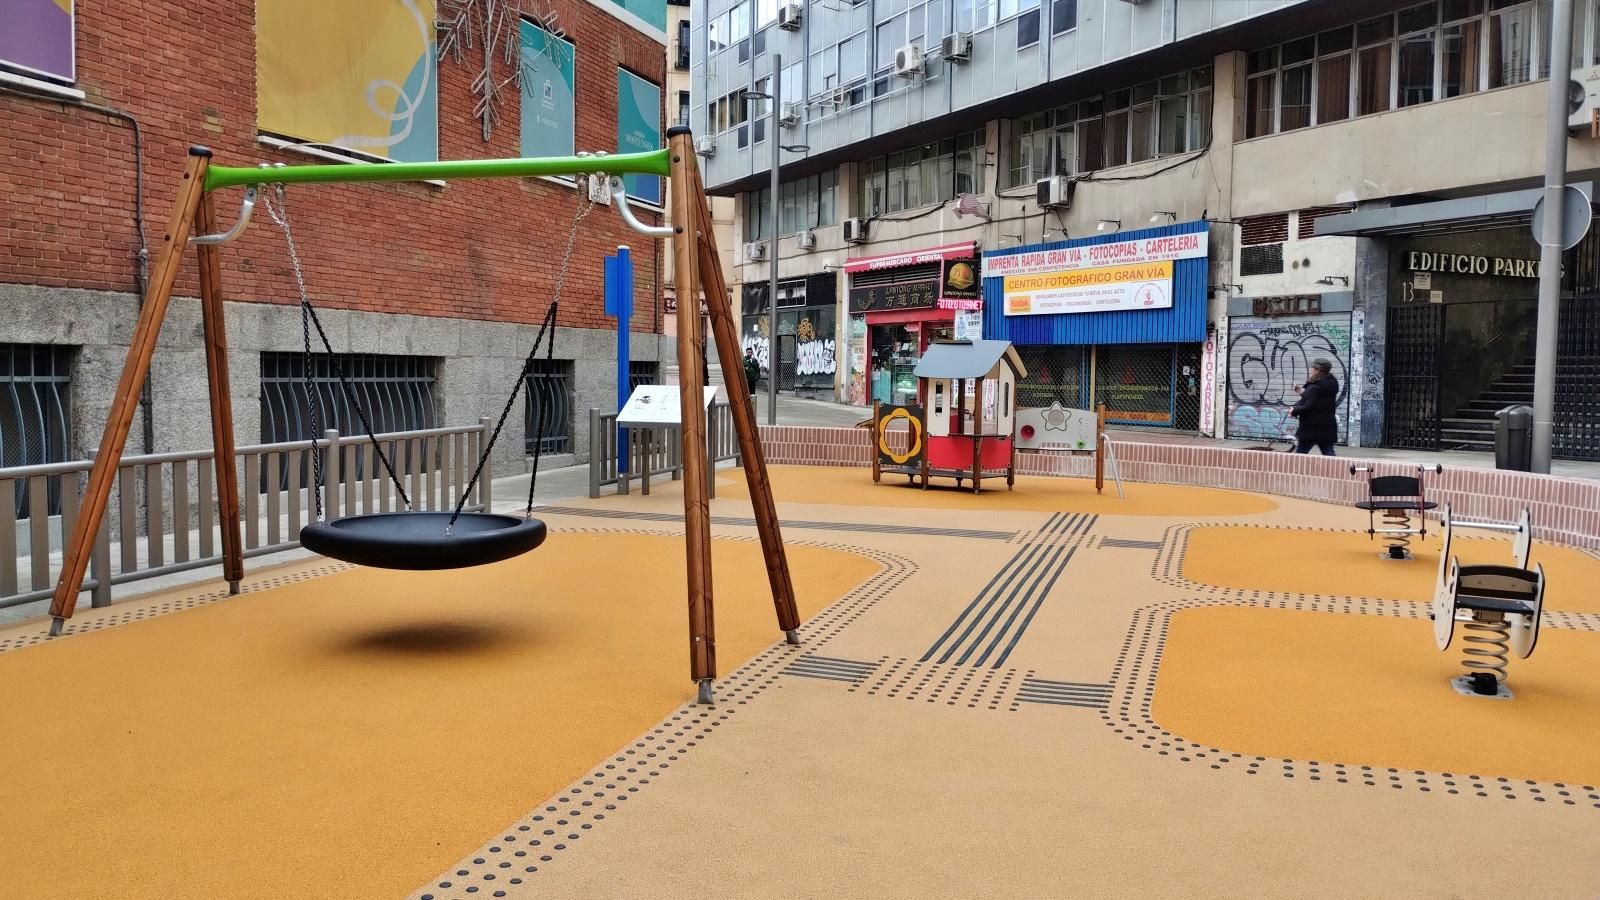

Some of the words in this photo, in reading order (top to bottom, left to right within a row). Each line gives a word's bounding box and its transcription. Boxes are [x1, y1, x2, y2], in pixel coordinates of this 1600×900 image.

[869, 257, 913, 269] SUPERMERCADO
[916, 253, 944, 262] ORIENTAL
[988, 256, 1019, 270] IMPRENTA
[1021, 254, 1046, 267] RAPIDA
[1047, 251, 1067, 264] GRAN
[1069, 249, 1081, 261] VIA
[1089, 242, 1137, 260] FOTOCOPIAS
[1146, 235, 1199, 254] CARTELERIA
[1112, 257, 1146, 265] FUNDADA
[1409, 251, 1489, 275] EDIFICIO
[1008, 278, 1043, 290] CENTRO
[1114, 270, 1144, 282] GRAN
[1401, 281, 1415, 303] 13
[1204, 329, 1214, 433] FOTOCARNET
